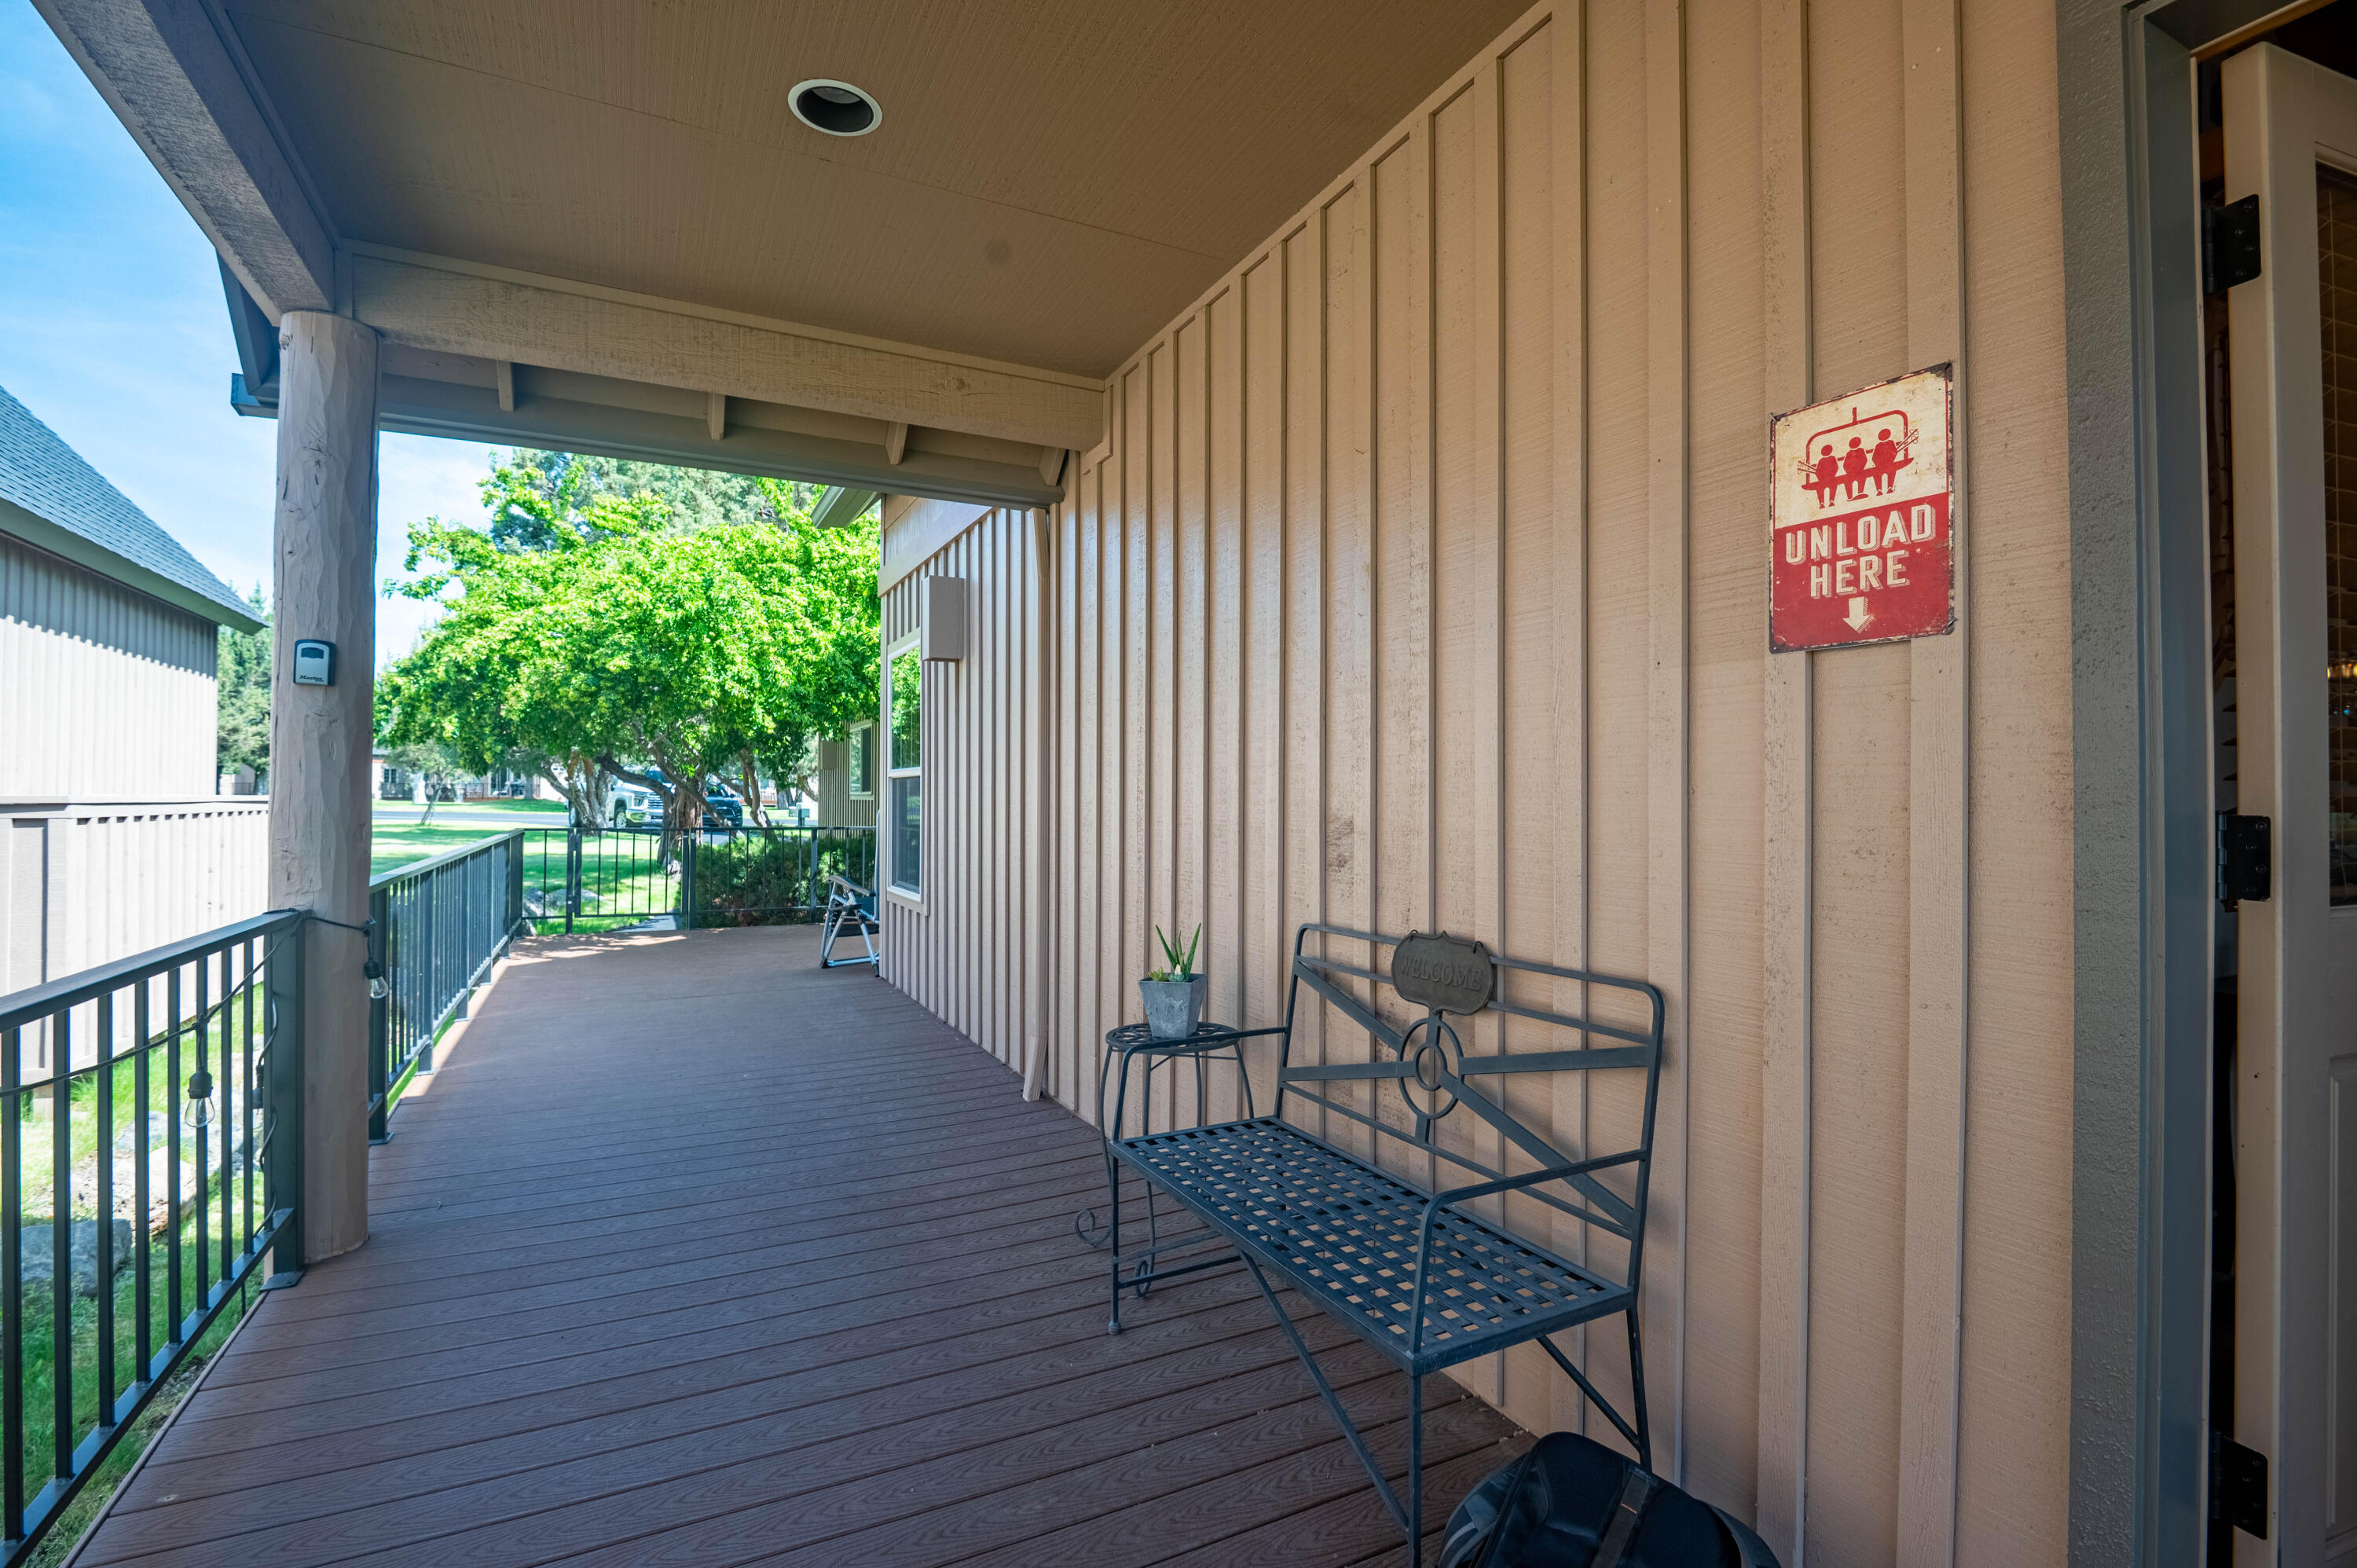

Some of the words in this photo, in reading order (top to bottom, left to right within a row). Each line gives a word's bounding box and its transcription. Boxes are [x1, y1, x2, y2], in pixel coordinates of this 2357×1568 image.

[1786, 504, 1936, 564] UNLOAD
[1810, 550, 1910, 599] HERE
[1400, 954, 1483, 992] WELCOME
